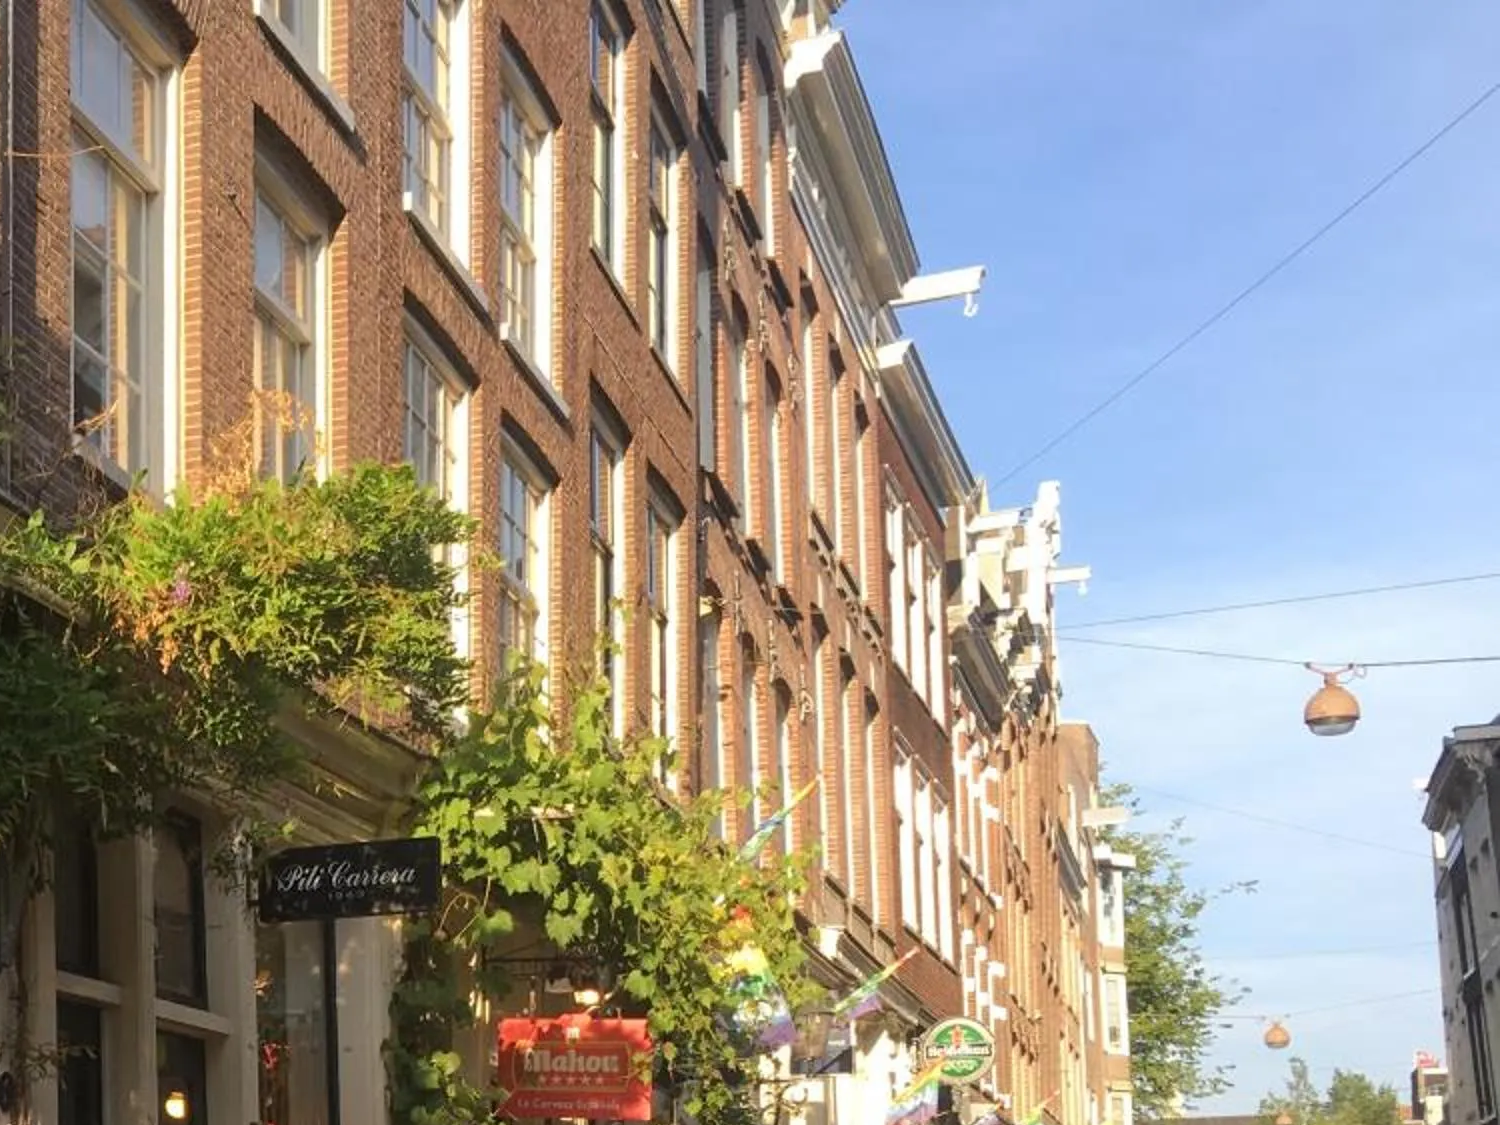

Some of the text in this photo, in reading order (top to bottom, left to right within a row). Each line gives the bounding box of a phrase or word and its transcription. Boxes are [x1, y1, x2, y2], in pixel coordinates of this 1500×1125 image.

[277, 861, 417, 891] Pili Carrera
[524, 1048, 620, 1073] Mahou
